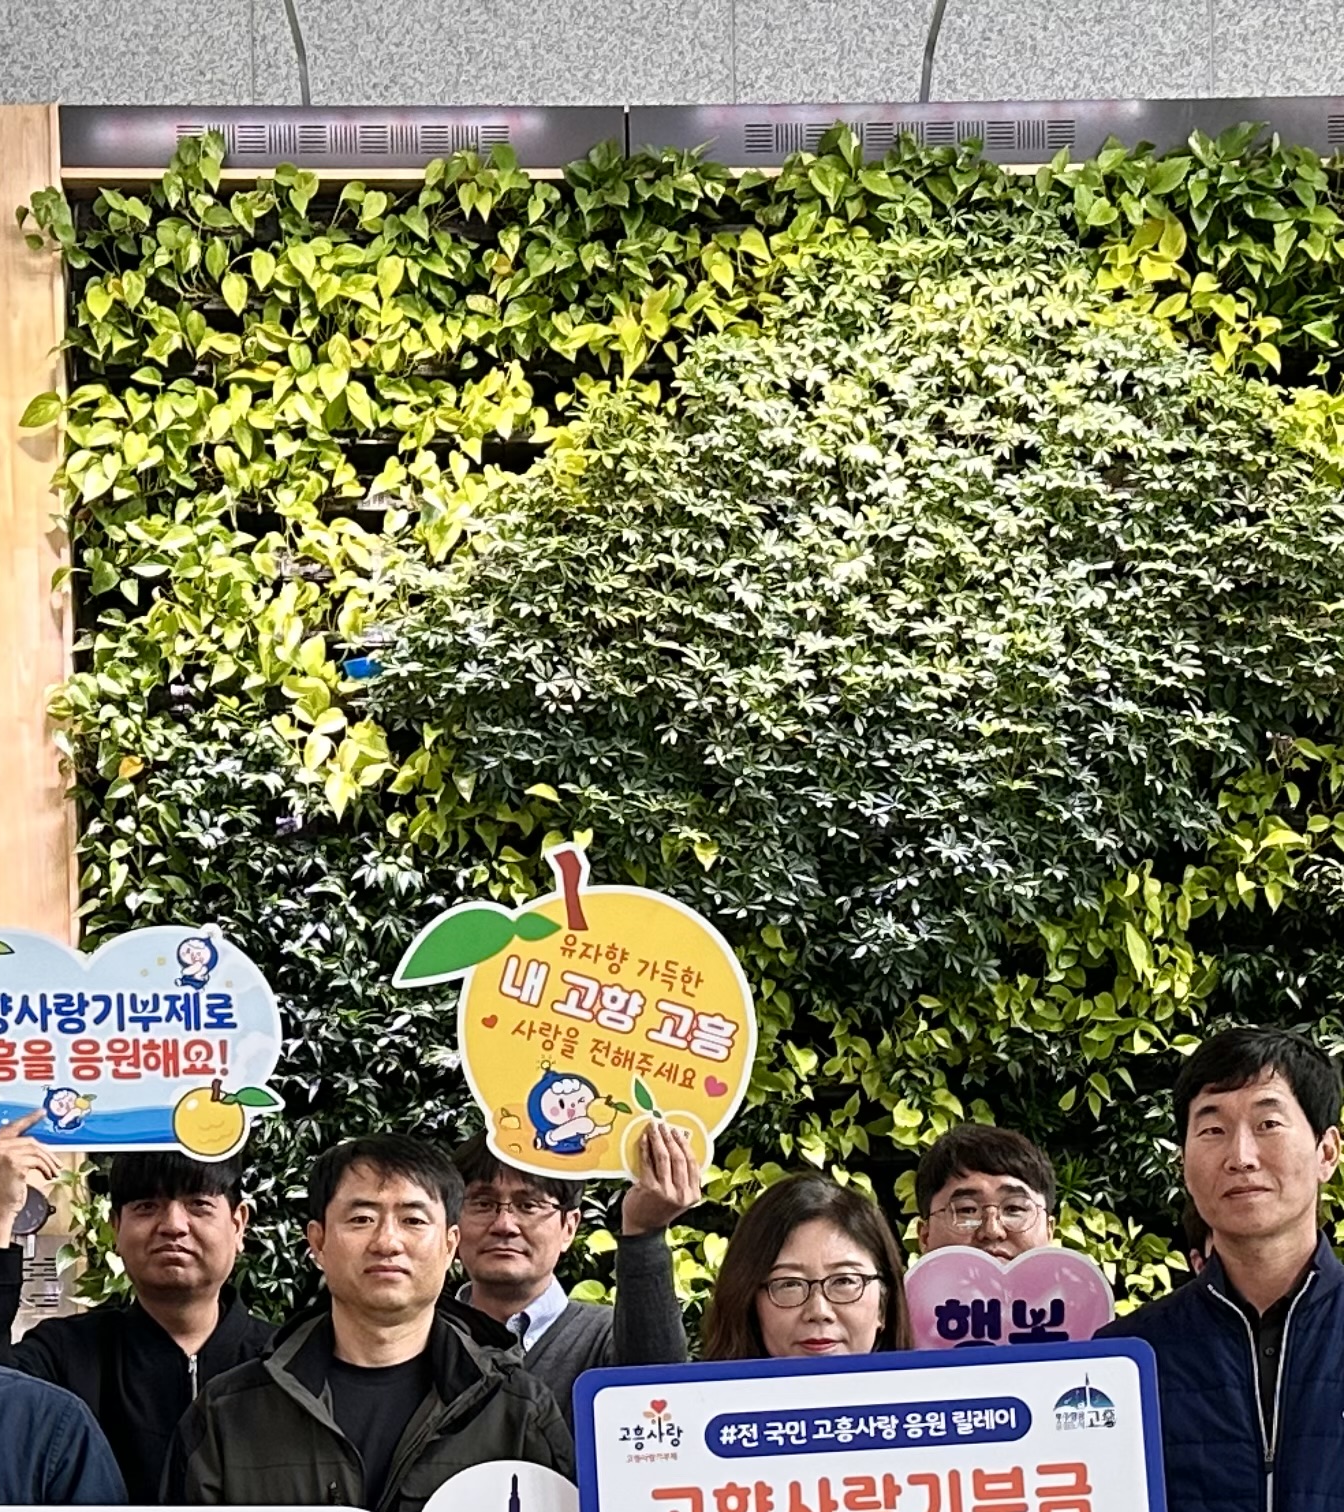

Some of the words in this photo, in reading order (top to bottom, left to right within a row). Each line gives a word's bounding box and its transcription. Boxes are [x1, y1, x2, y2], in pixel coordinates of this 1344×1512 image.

[559, 934, 629, 975] 유자향
[637, 958, 704, 998] 가득한
[498, 954, 551, 1007] 내
[551, 970, 647, 1034] 고향
[646, 999, 739, 1063] 고흥
[68, 1036, 230, 1081] 응원해요!
[511, 1019, 581, 1060] 사랑을
[589, 1037, 697, 1091] 전해주세요
[618, 1416, 684, 1451] 고흥사랑
[718, 1423, 759, 1448] #전
[763, 1419, 808, 1446] 국민
[812, 1414, 899, 1443] 고흥사랑
[903, 1411, 947, 1439] 응원
[952, 1407, 1017, 1435] 릴레이
